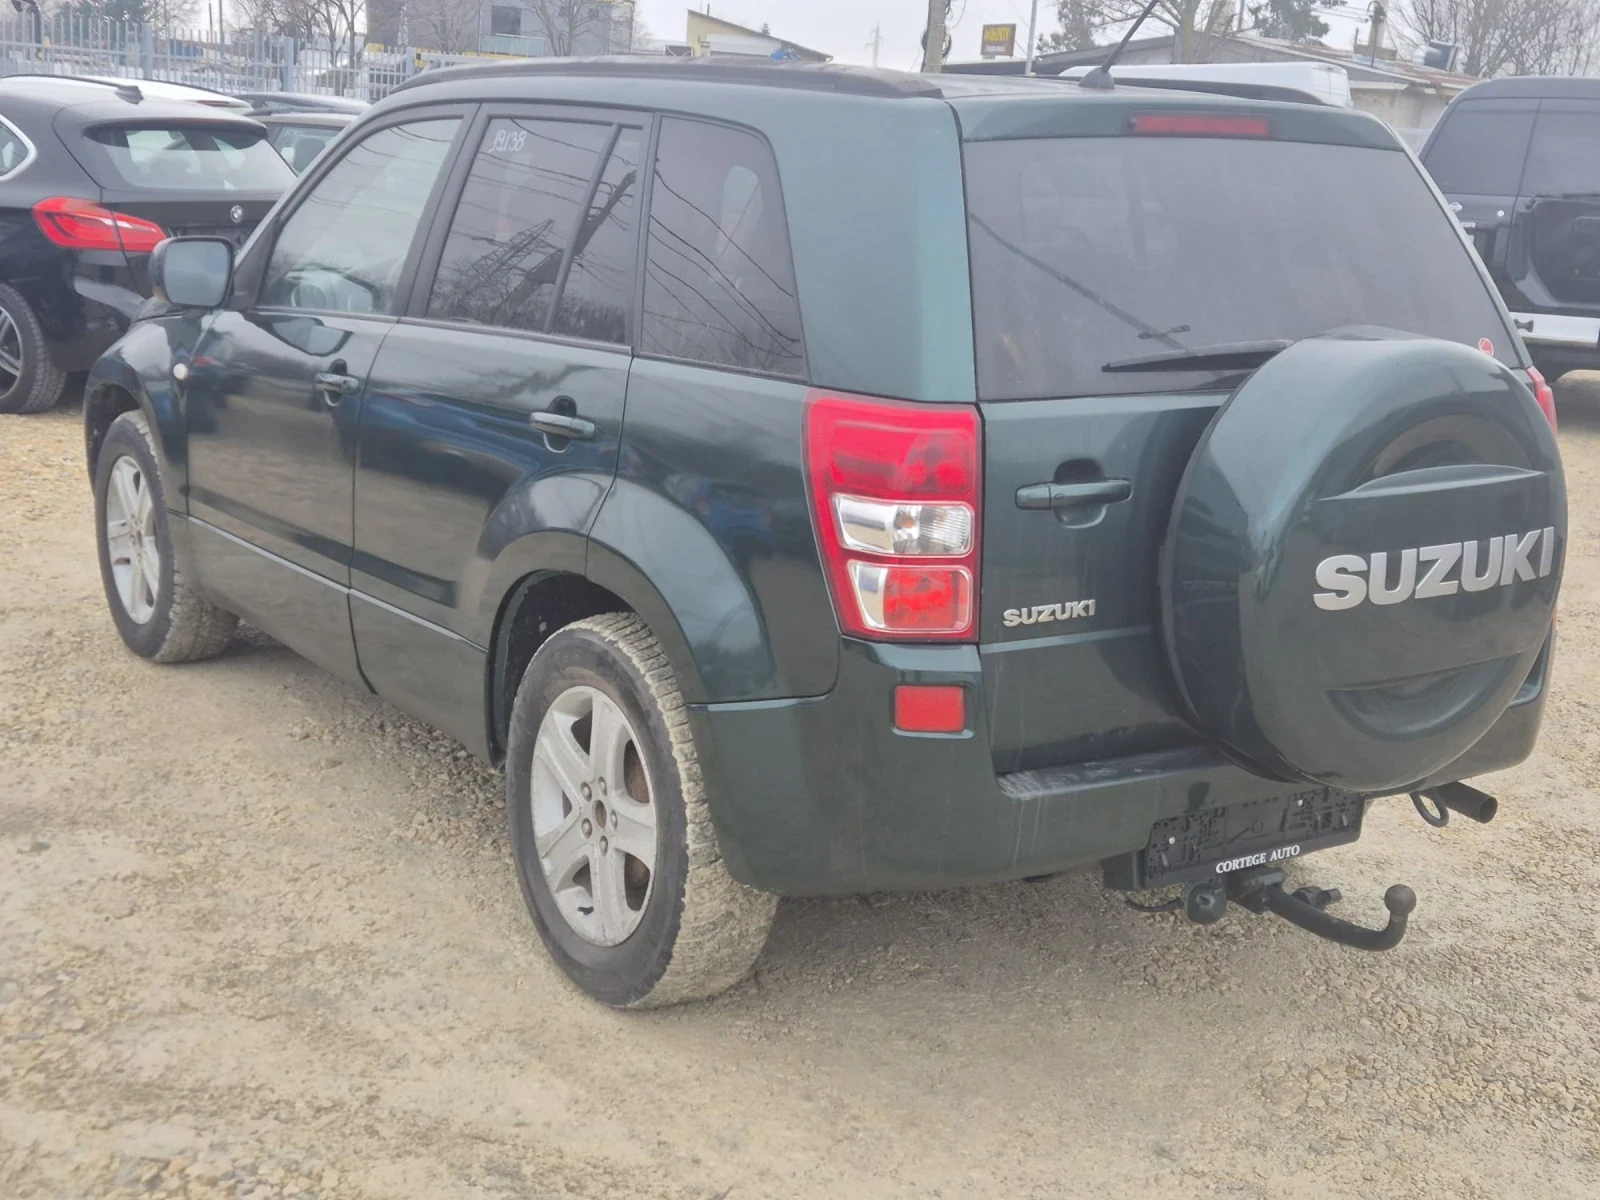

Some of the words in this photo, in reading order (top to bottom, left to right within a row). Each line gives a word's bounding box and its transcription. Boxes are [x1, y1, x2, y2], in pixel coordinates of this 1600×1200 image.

[1313, 526, 1555, 611] SUZUKI
[1002, 599, 1096, 627] SUZUKI
[1215, 852, 1267, 874] CORTEGE
[1269, 844, 1300, 862] AUTO
